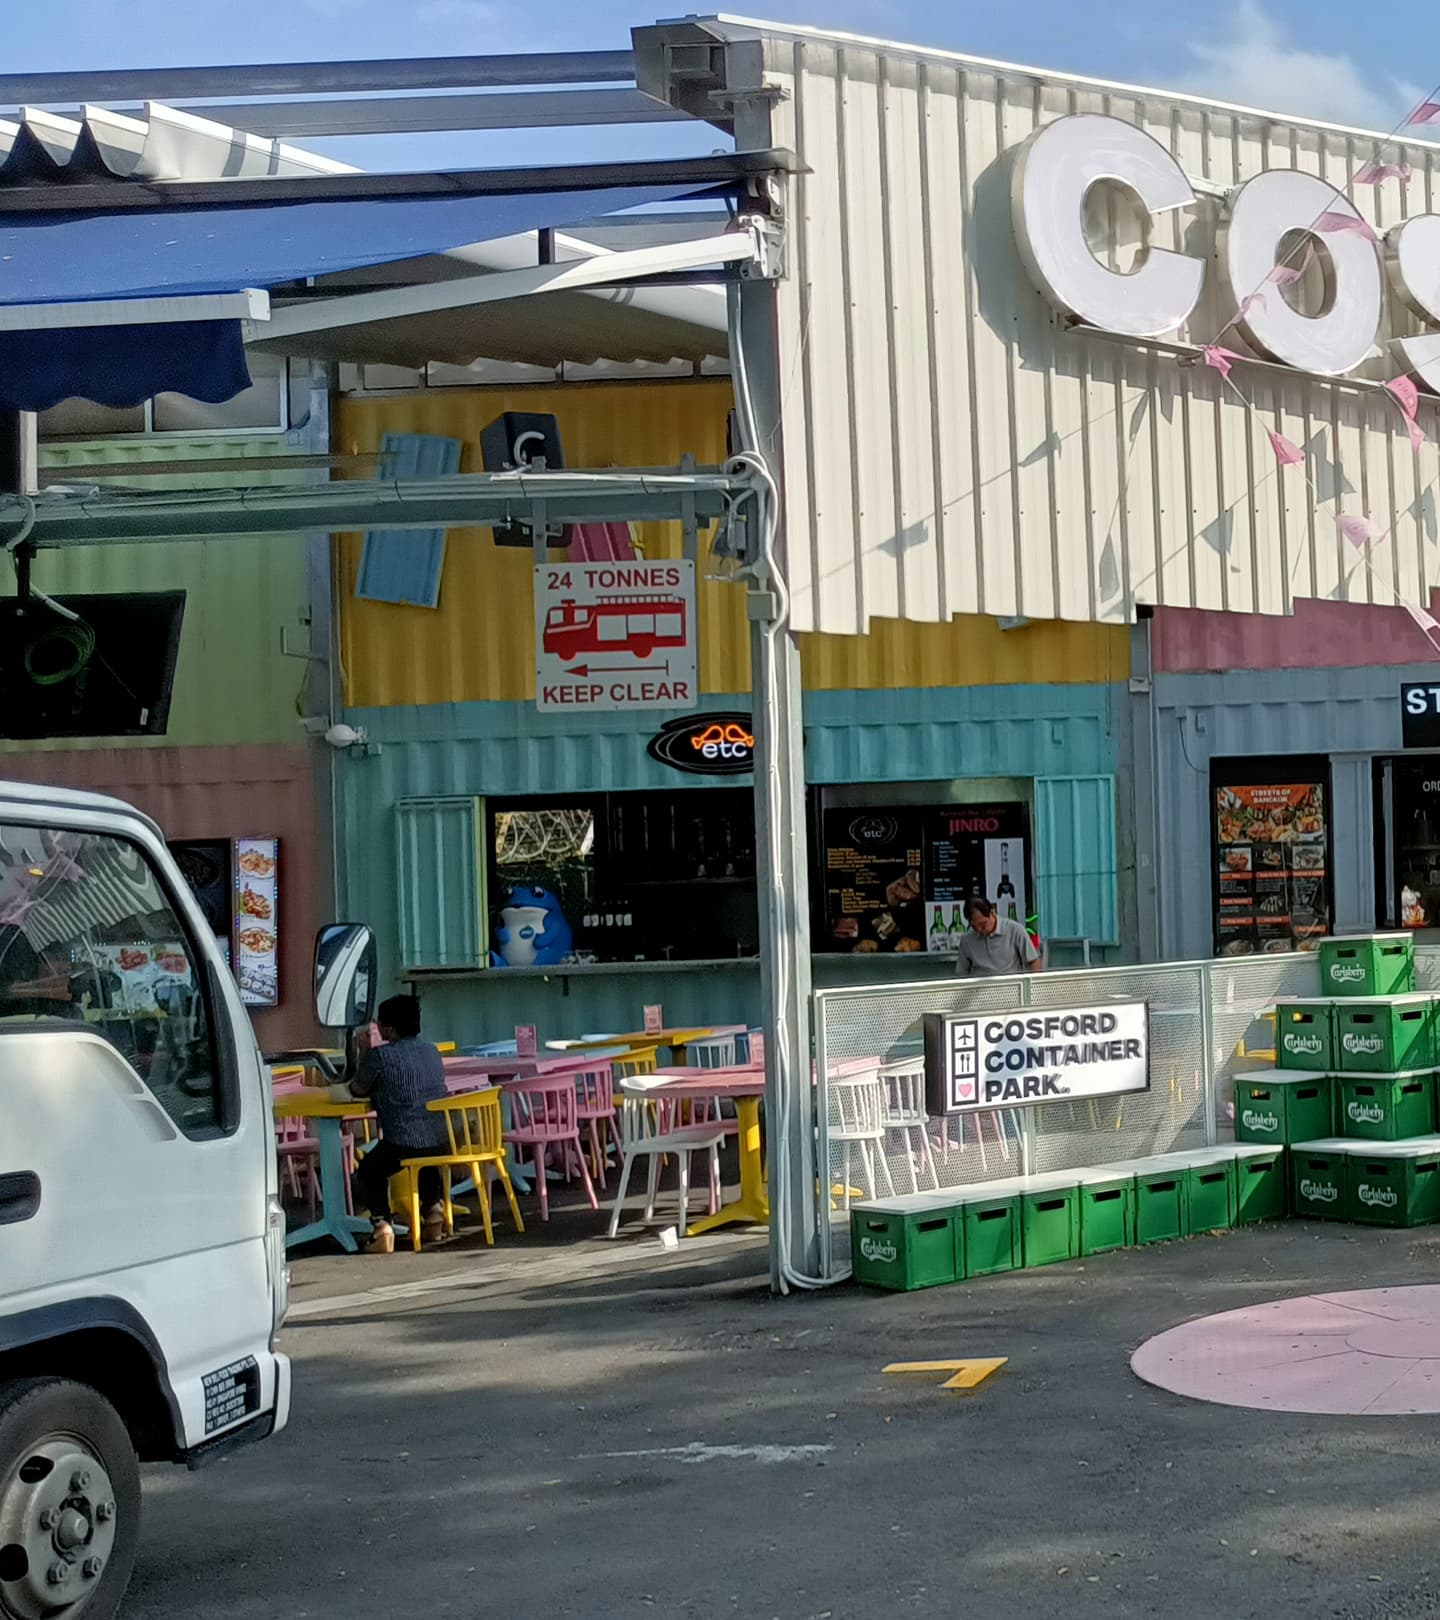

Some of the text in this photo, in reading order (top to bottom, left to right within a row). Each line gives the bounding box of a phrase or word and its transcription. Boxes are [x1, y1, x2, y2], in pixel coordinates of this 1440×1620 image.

[547, 568, 680, 590] 24 TONNES
[543, 682, 688, 704] KEEP CLEAR
[702, 740, 748, 758] etc
[948, 817, 1000, 837] JINRO
[1330, 963, 1366, 983] Carlsberg
[984, 1012, 1118, 1044] COSFORD
[1283, 1033, 1323, 1055] Carlsberg
[1342, 1033, 1384, 1055] Carlsberg
[984, 1038, 1143, 1074] CONTAINER
[1242, 1110, 1278, 1132] Carlsberg
[1347, 1102, 1385, 1124] Carlsberg
[1300, 1179, 1338, 1202] Carlsberg
[1358, 1184, 1398, 1208] Carlsberg
[861, 1237, 897, 1262] Carlsberg
